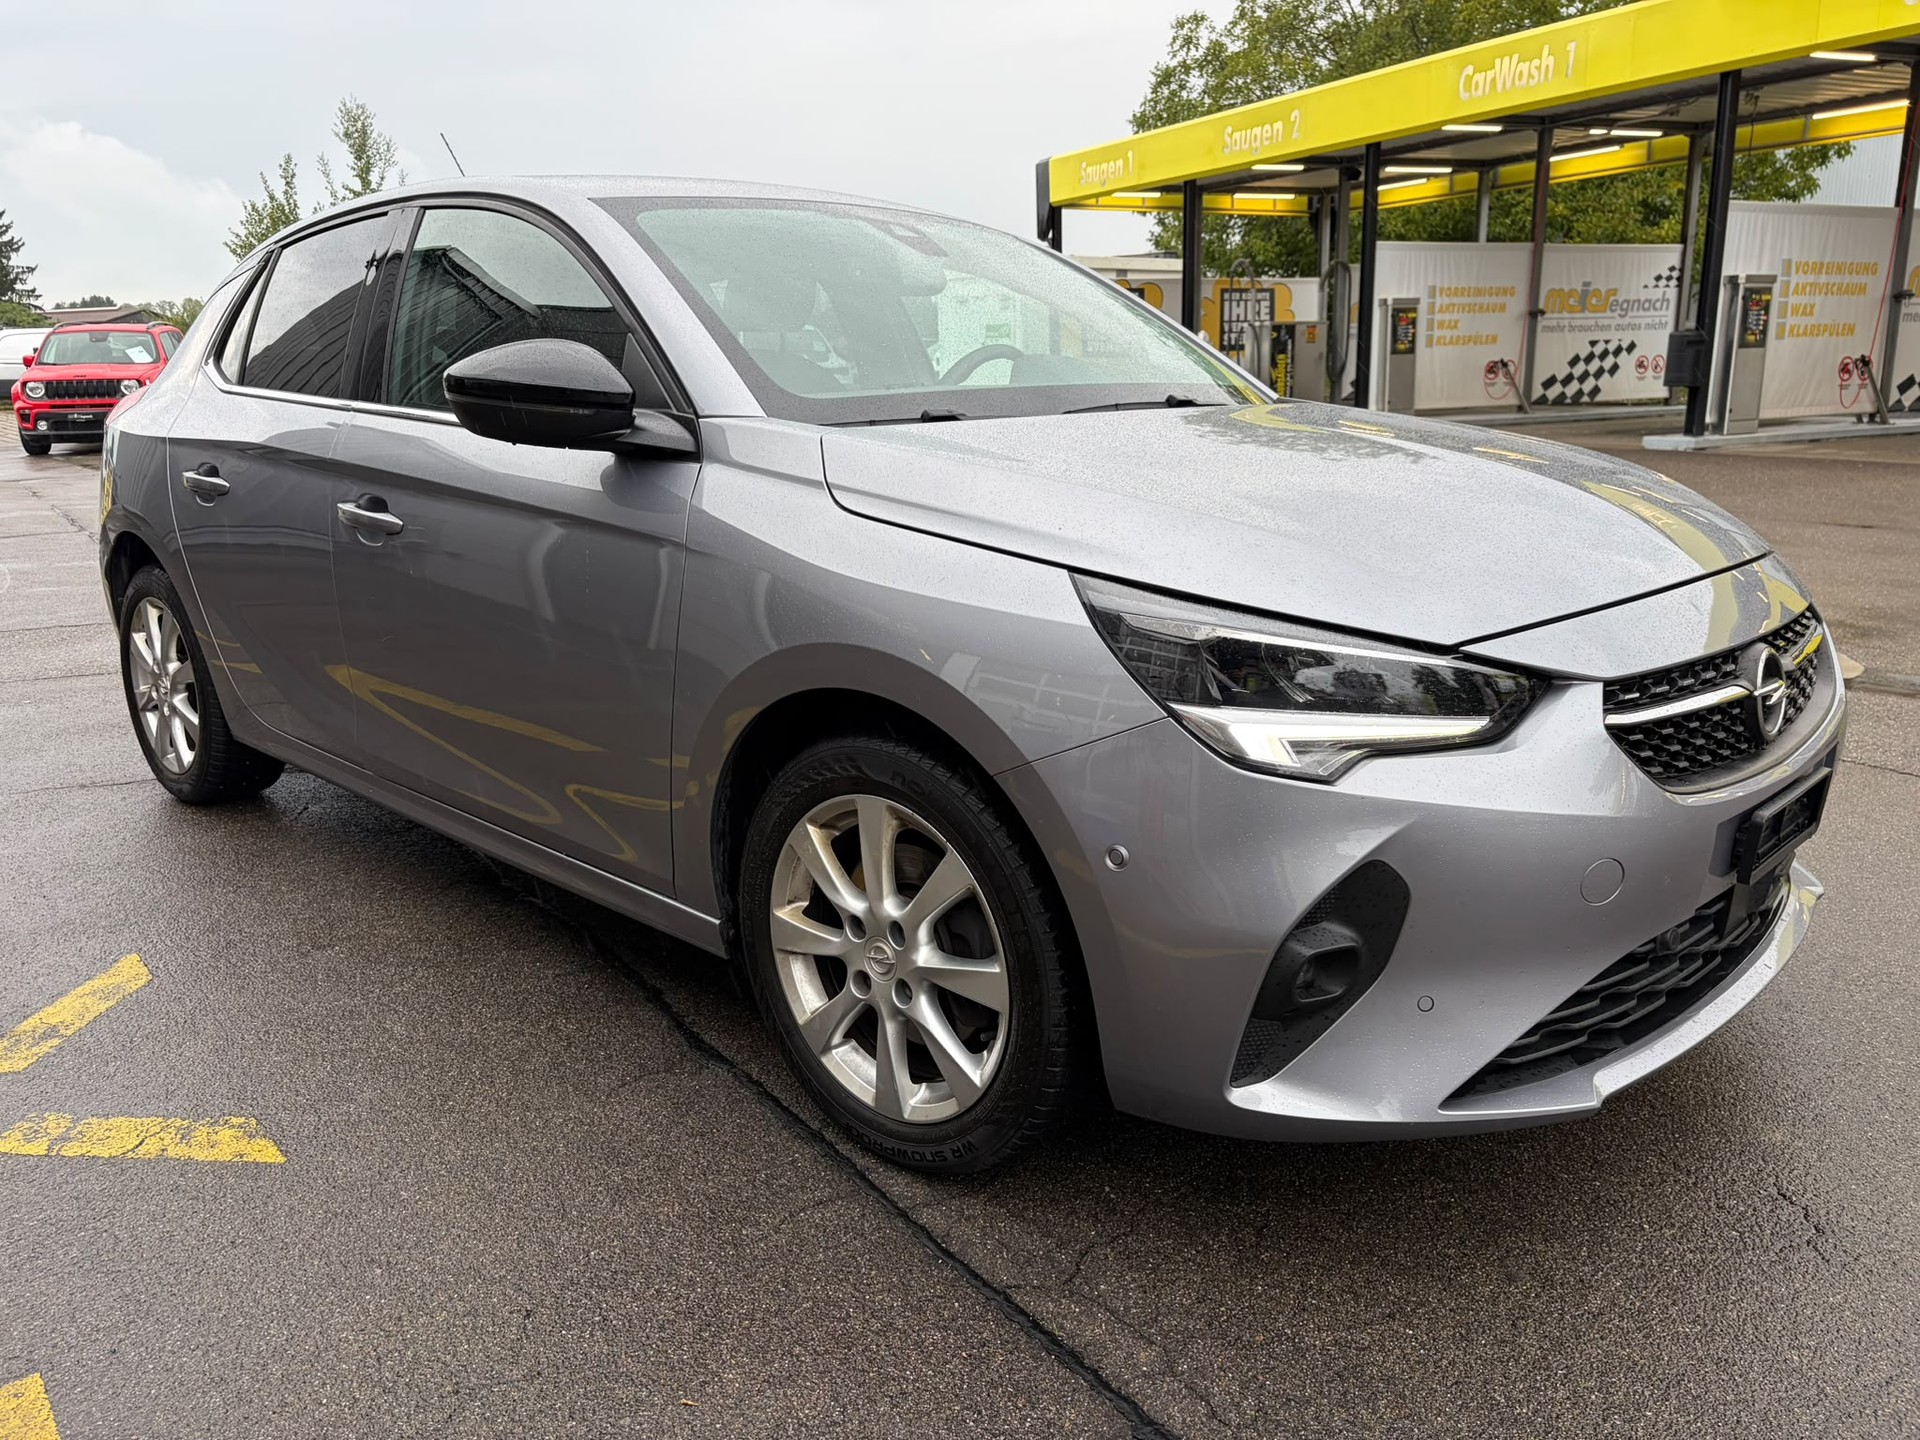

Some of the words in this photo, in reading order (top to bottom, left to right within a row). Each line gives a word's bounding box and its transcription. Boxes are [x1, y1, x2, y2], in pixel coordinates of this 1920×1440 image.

[1459, 44, 1555, 102] CarWash
[1566, 41, 1577, 79] 1
[1223, 120, 1283, 155] Saugen
[1290, 109, 1300, 140] 2
[1079, 158, 1124, 187] Saugen
[1127, 150, 1134, 176] 1
[1794, 260, 1878, 276] VORREINIGUNG
[1438, 286, 1516, 298] VORREINIGUNG
[1791, 282, 1868, 296] AKTIVSCHAUM
[1223, 300, 1271, 321] IHRE
[1437, 302, 1507, 314] AKTIVSCHAUM
[1790, 303, 1816, 317] WAX
[1436, 319, 1460, 330] WAX
[1541, 321, 1567, 333] mehr
[1567, 321, 1612, 333] brauchen
[1614, 322, 1641, 332] autos
[1643, 319, 1668, 331] nicht
[1787, 321, 1856, 338] KLARSPÜLEN
[1435, 333, 1498, 346] KLARSPÜLEN
